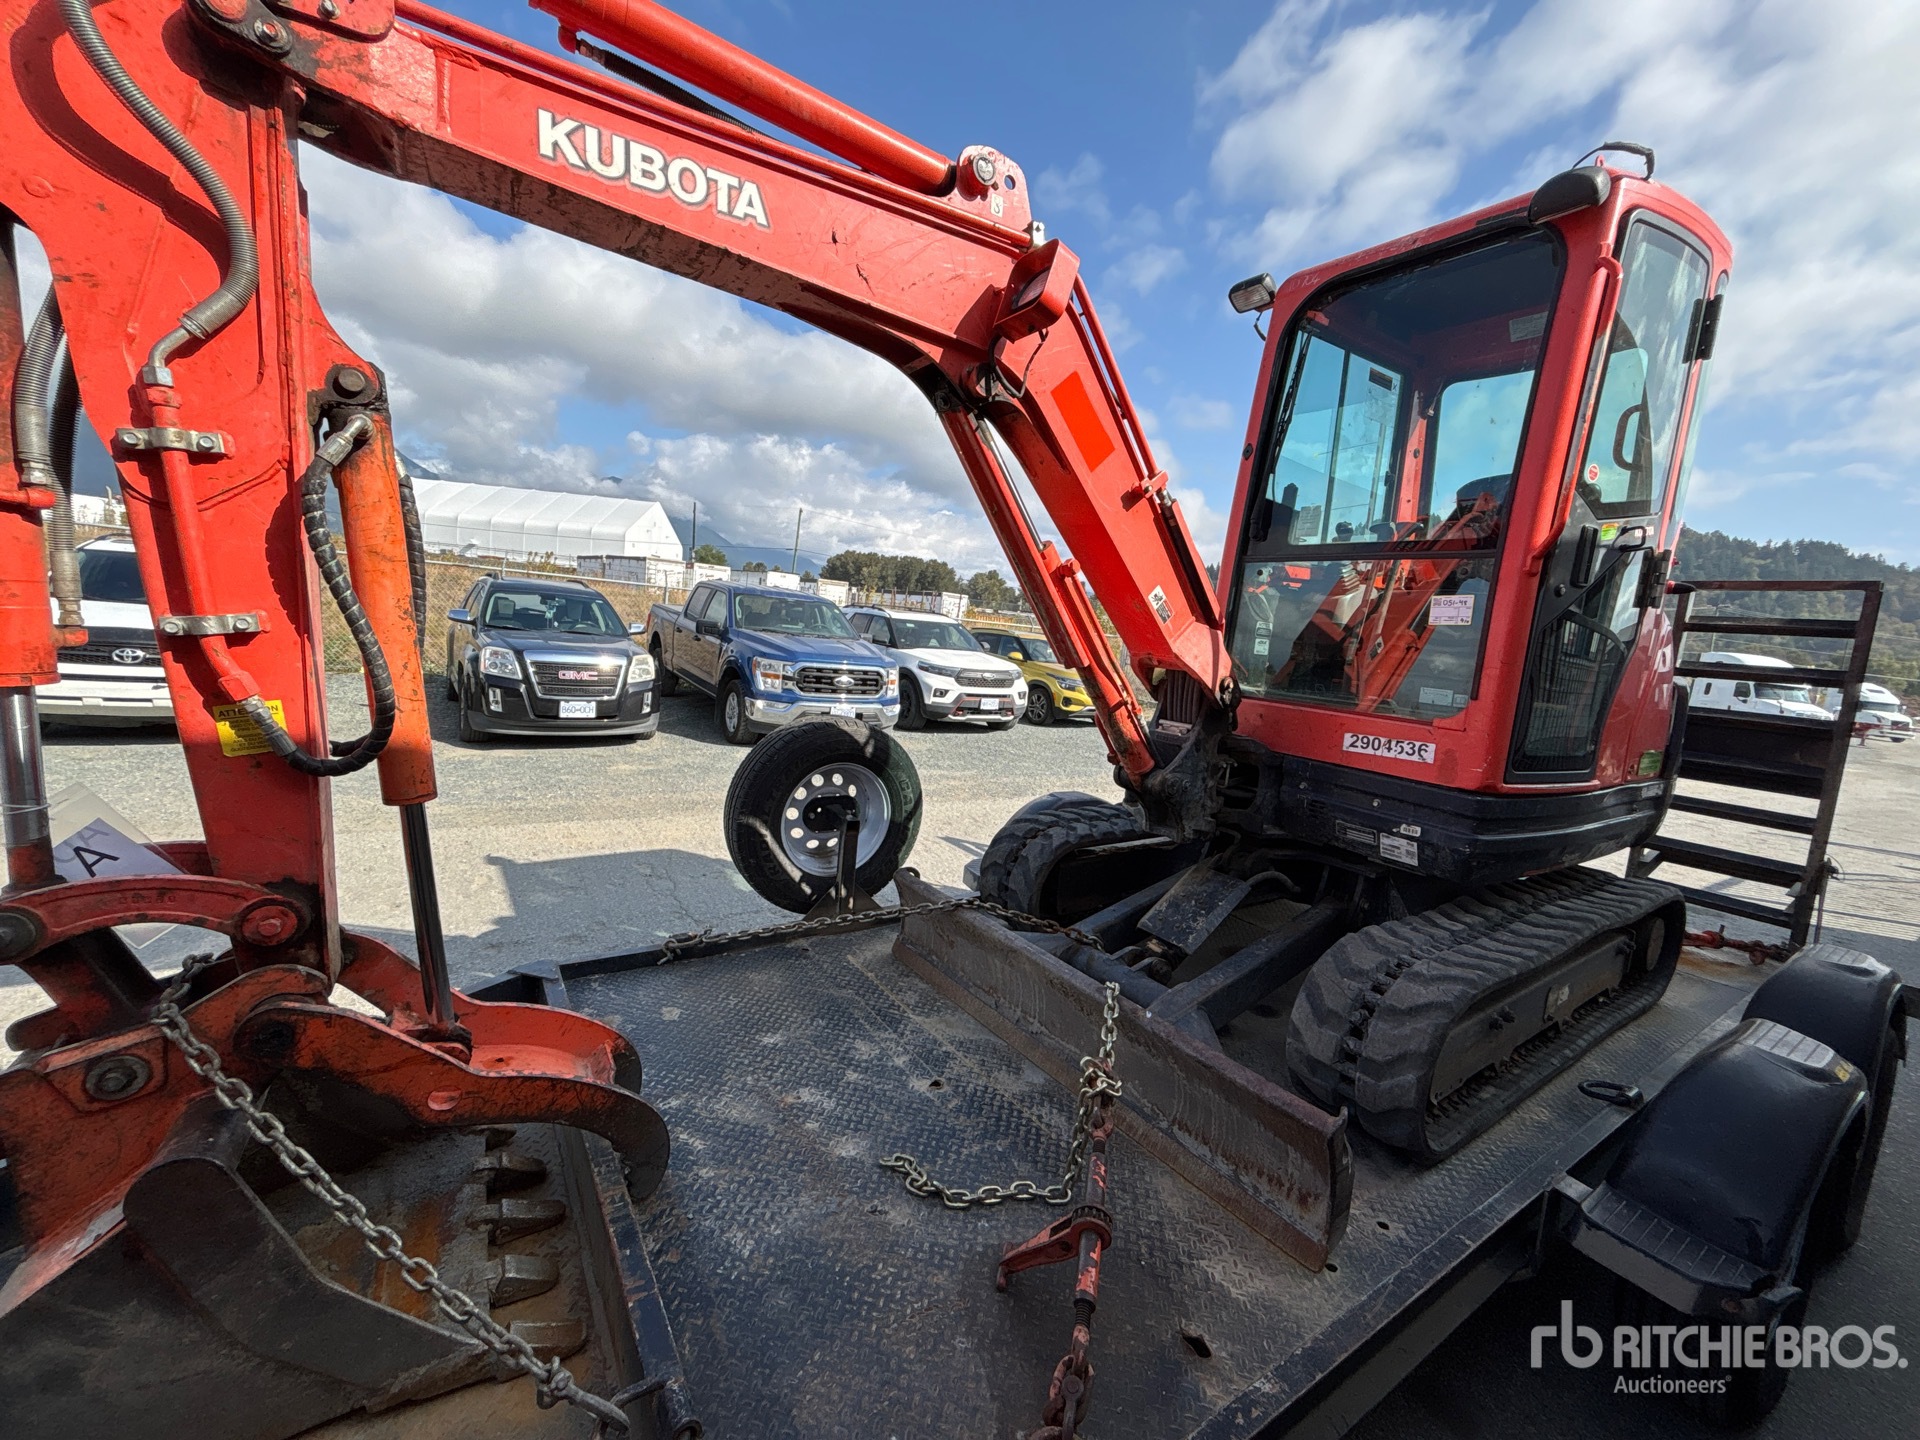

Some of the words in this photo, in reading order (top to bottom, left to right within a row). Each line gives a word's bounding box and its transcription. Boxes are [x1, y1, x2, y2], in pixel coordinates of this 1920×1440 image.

[537, 107, 771, 229] KUBOTA
[558, 670, 598, 681] GMC
[1348, 734, 1429, 761] 2904536
